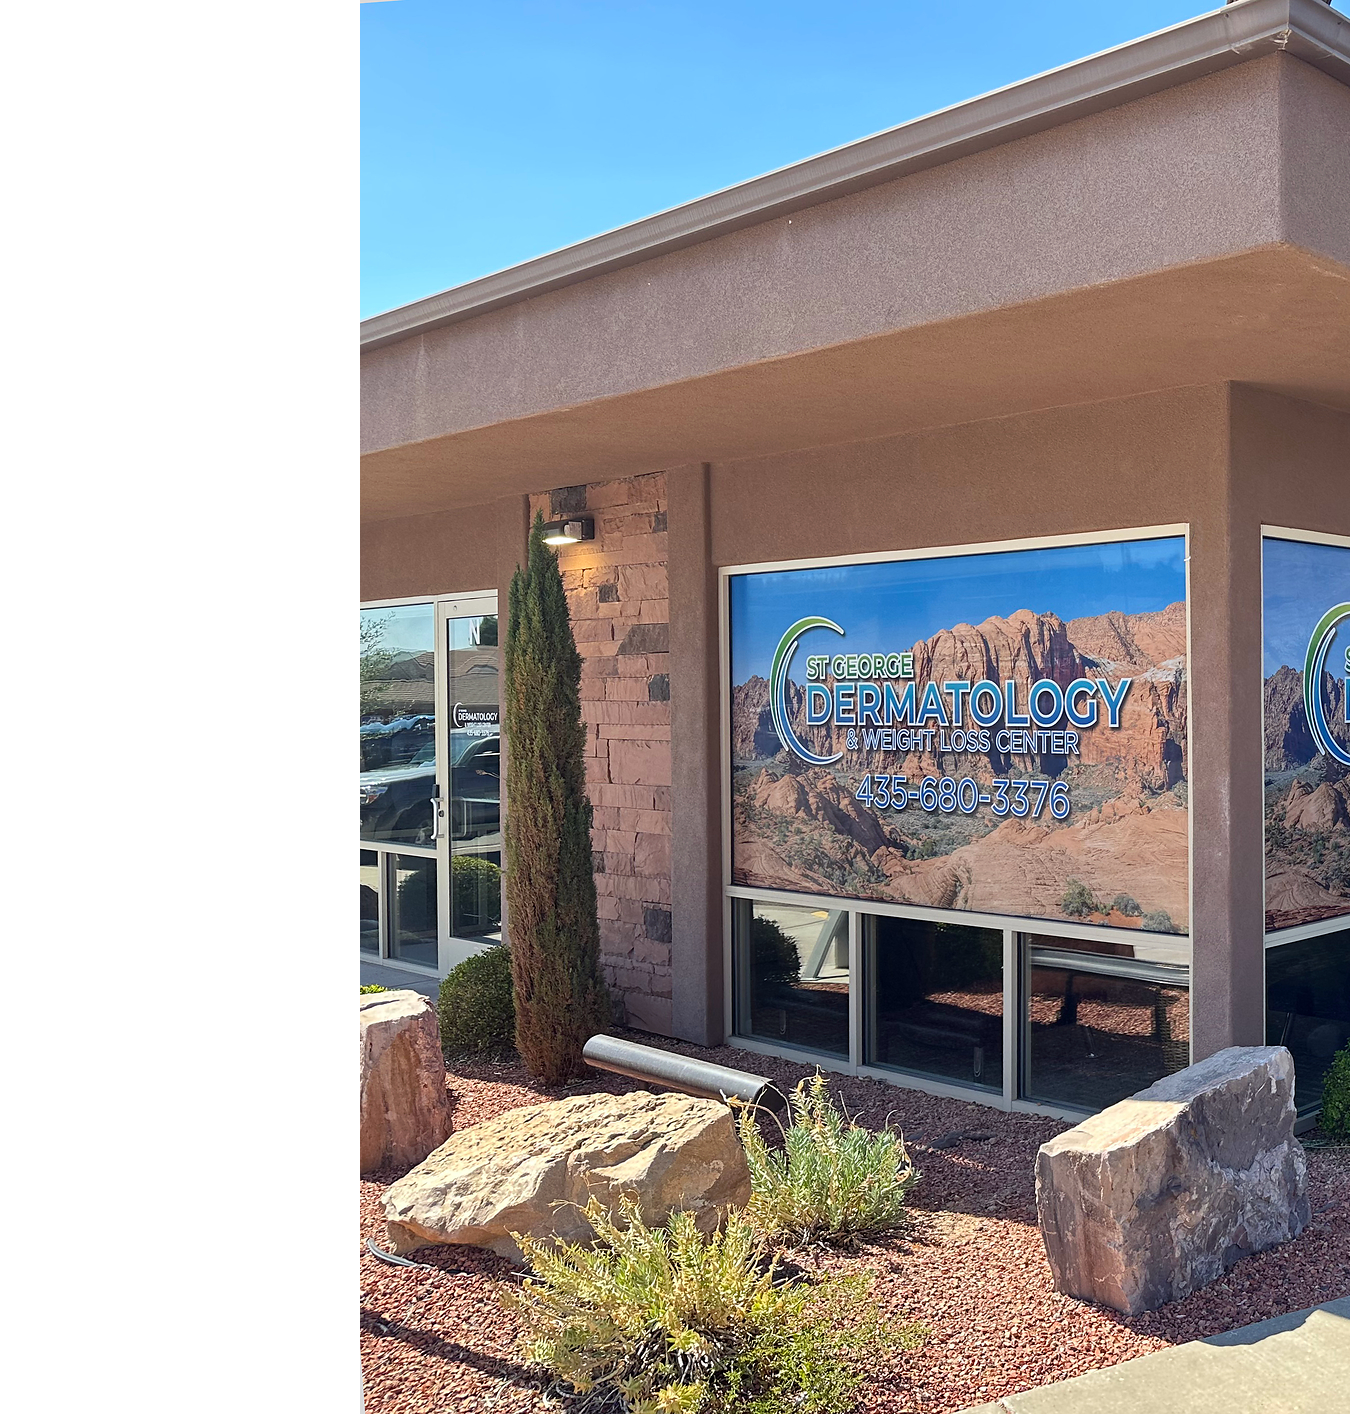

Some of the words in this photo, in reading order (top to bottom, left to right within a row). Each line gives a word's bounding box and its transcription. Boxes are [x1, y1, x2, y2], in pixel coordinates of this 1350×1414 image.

[805, 654, 830, 678] ST
[831, 652, 914, 678] GEORGE
[806, 677, 1133, 728] DERMATOLOGY
[458, 712, 498, 721] DERMATOLOGY
[846, 728, 858, 750] &
[862, 729, 935, 752] WEIGHT
[940, 729, 990, 753] LOSS
[995, 729, 1080, 755] CENTER
[855, 773, 1070, 819] 435-680-3376
